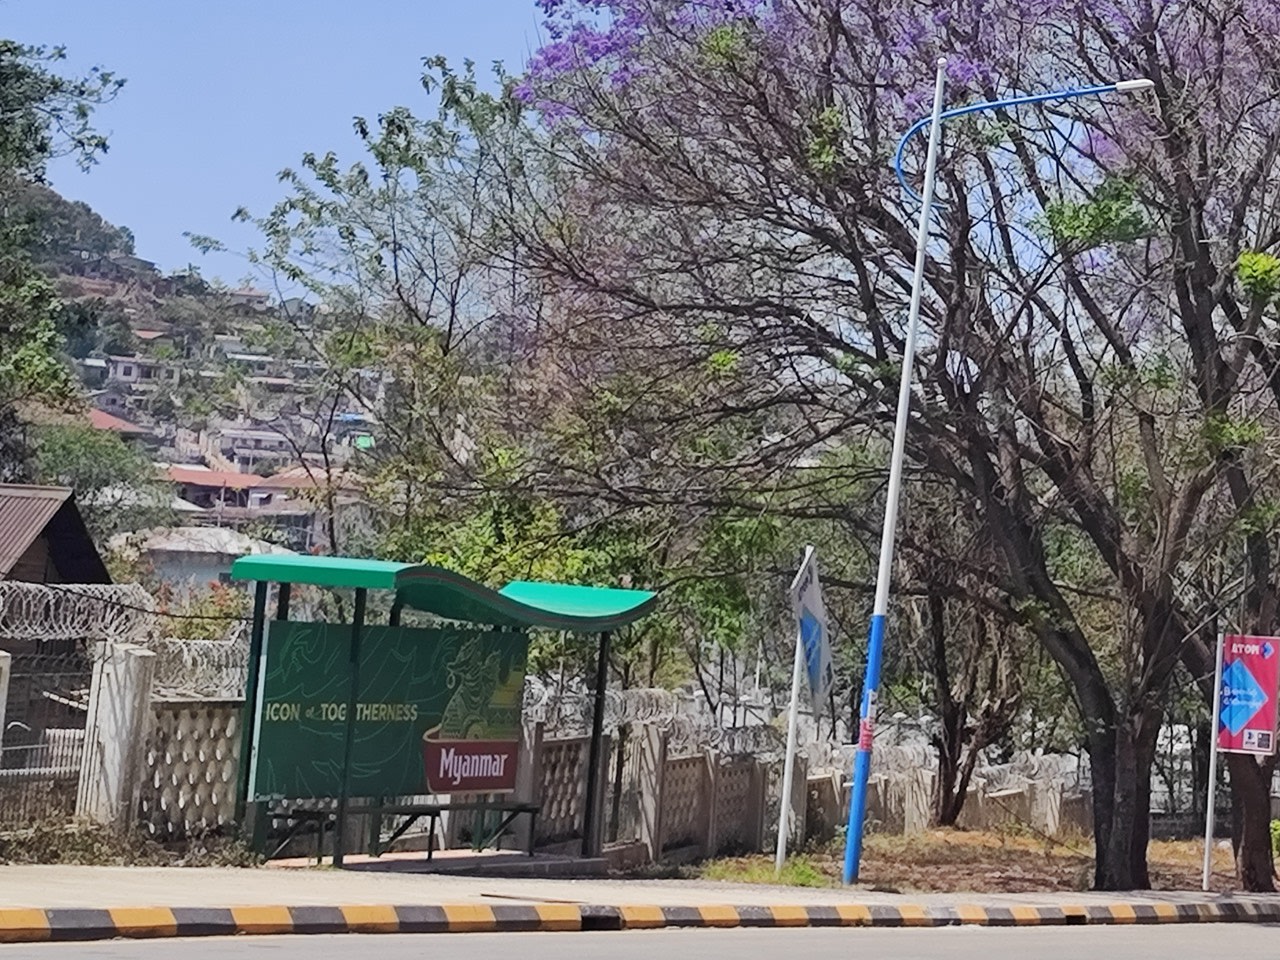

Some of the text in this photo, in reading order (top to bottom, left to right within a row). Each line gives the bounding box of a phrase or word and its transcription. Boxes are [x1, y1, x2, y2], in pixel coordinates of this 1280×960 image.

[1231, 643, 1259, 655] ATOM
[265, 703, 299, 721] ICON
[320, 703, 418, 721] TOGTHERNESS
[439, 747, 509, 785] Myanmar
